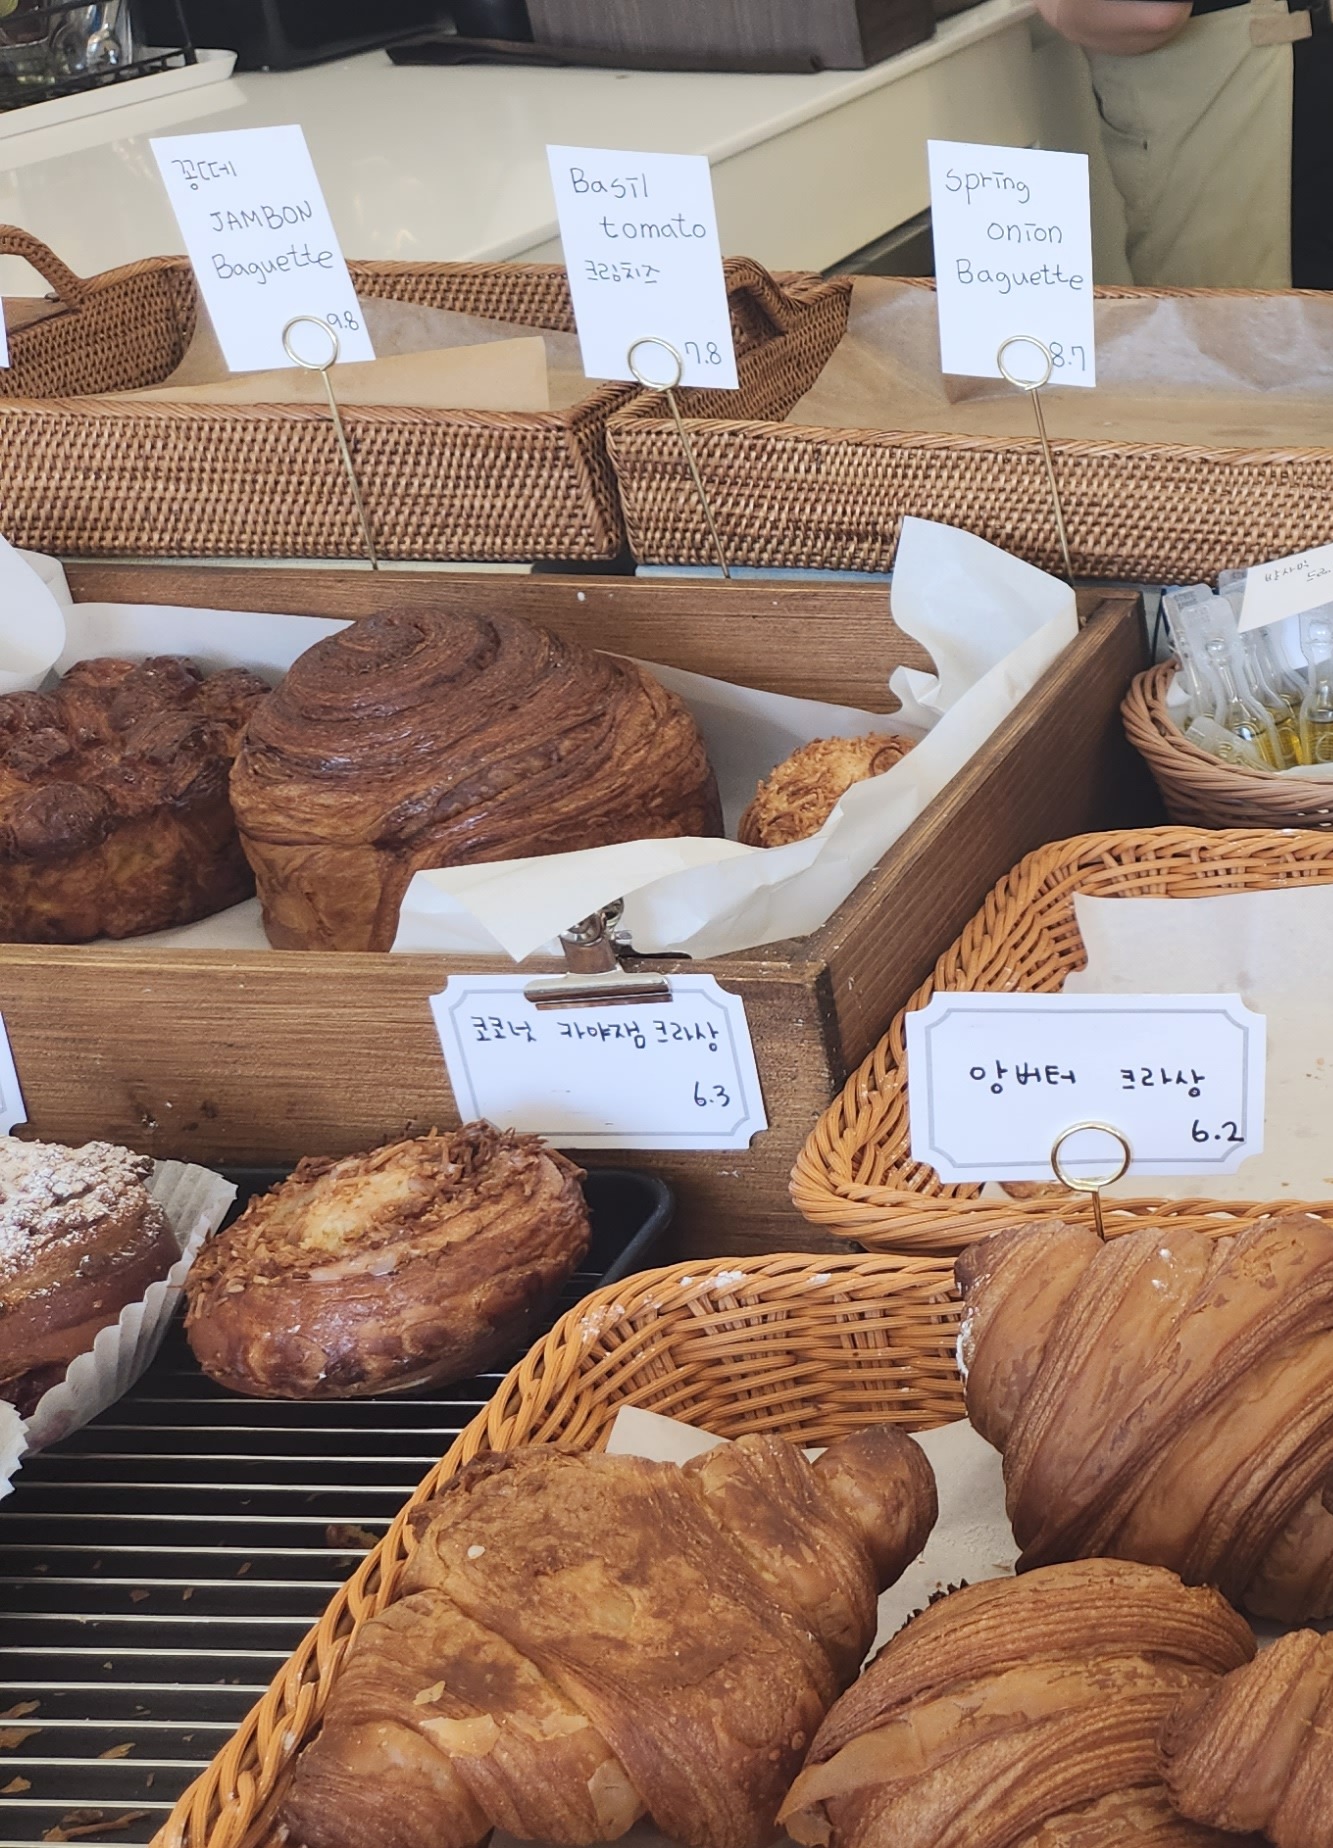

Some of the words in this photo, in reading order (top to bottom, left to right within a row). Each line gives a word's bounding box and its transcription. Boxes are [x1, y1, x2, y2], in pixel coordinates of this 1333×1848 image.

[569, 167, 648, 199] Basil
[209, 200, 313, 232] JAMBON
[598, 213, 706, 239] tomato
[211, 243, 334, 285] Baguette
[584, 259, 661, 284] 크림치즈
[955, 258, 1085, 295] Baguette
[326, 310, 360, 331] 9.8
[684, 341, 722, 366] 7.8
[1049, 341, 1087, 372] 8.7
[470, 1015, 537, 1043] 코코넛
[652, 1020, 720, 1052] 크라상
[692, 1080, 731, 1108] 6.3
[969, 1059, 1077, 1095] 앙버터
[1120, 1067, 1206, 1099] 크라상
[1190, 1118, 1246, 1144] 6.2
